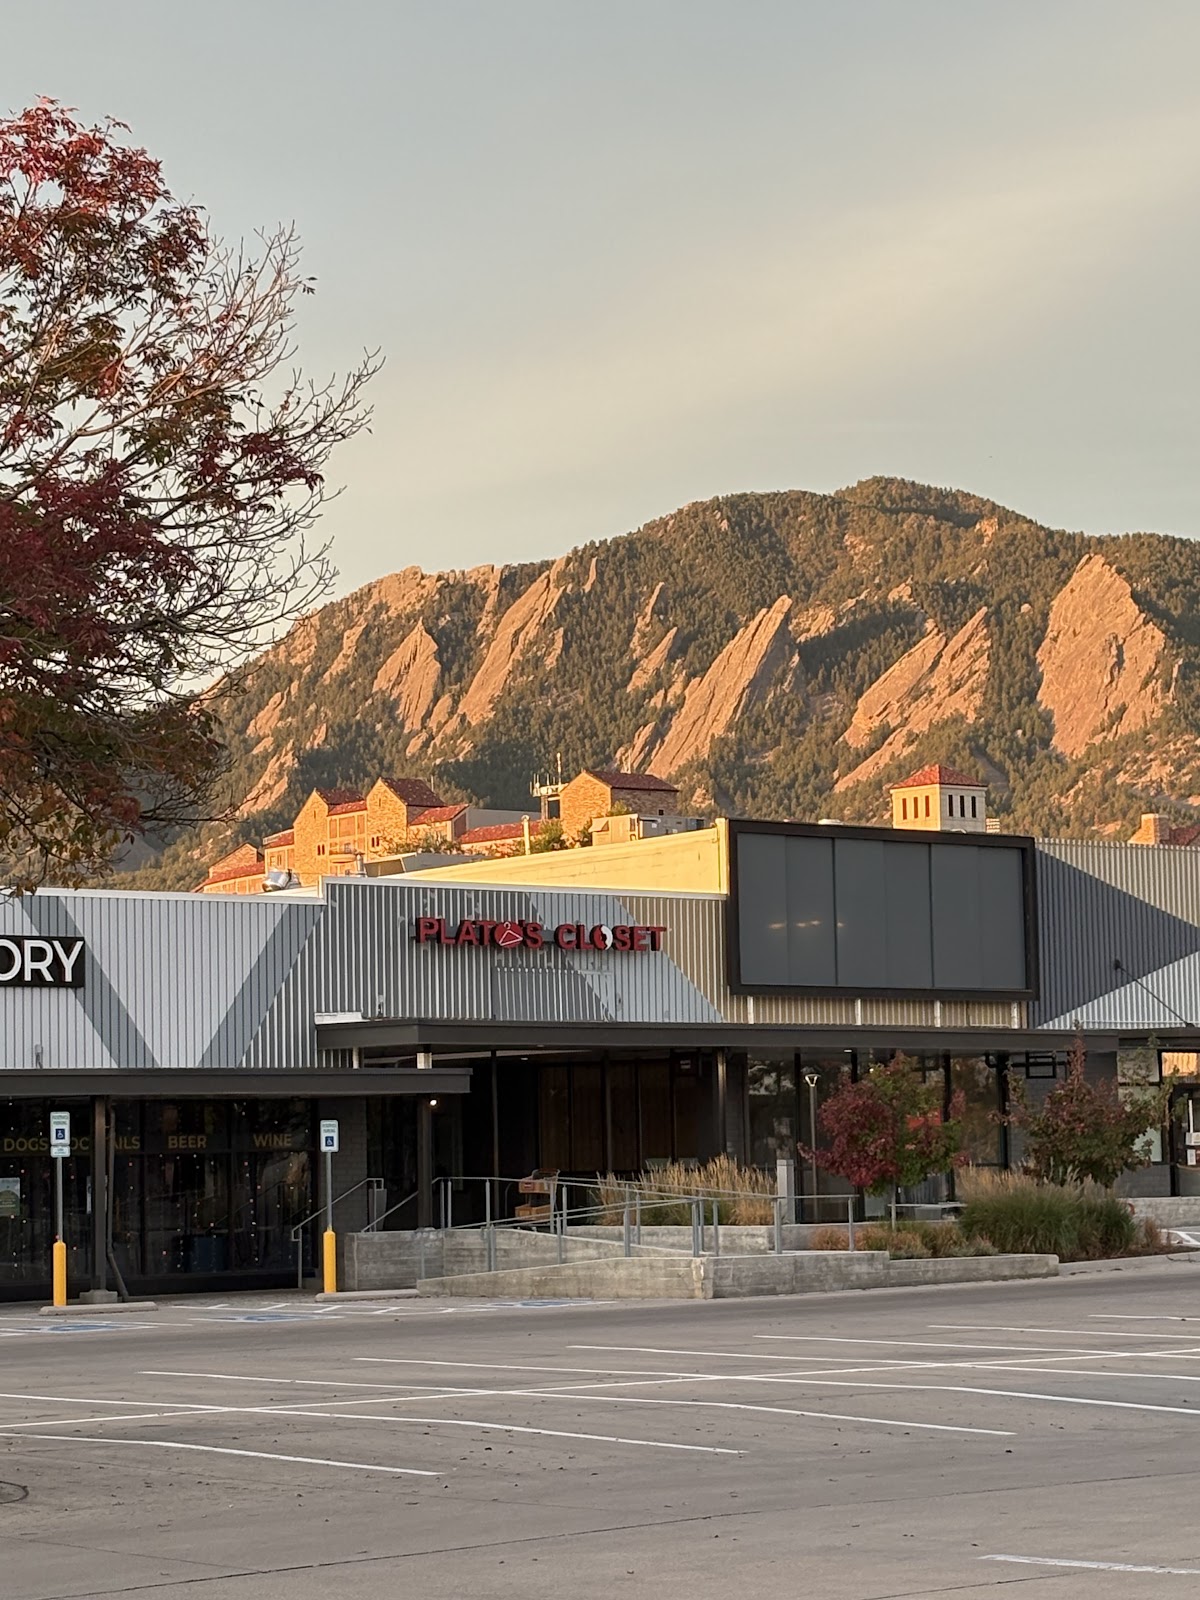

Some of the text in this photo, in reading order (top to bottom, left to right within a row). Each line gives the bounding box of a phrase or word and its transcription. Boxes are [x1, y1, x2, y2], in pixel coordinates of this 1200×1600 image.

[418, 916, 668, 952] PLATO'S CLOSET
[3, 1137, 49, 1152] DOGS
[168, 1135, 208, 1149] BEER
[252, 1133, 293, 1147] WINE
